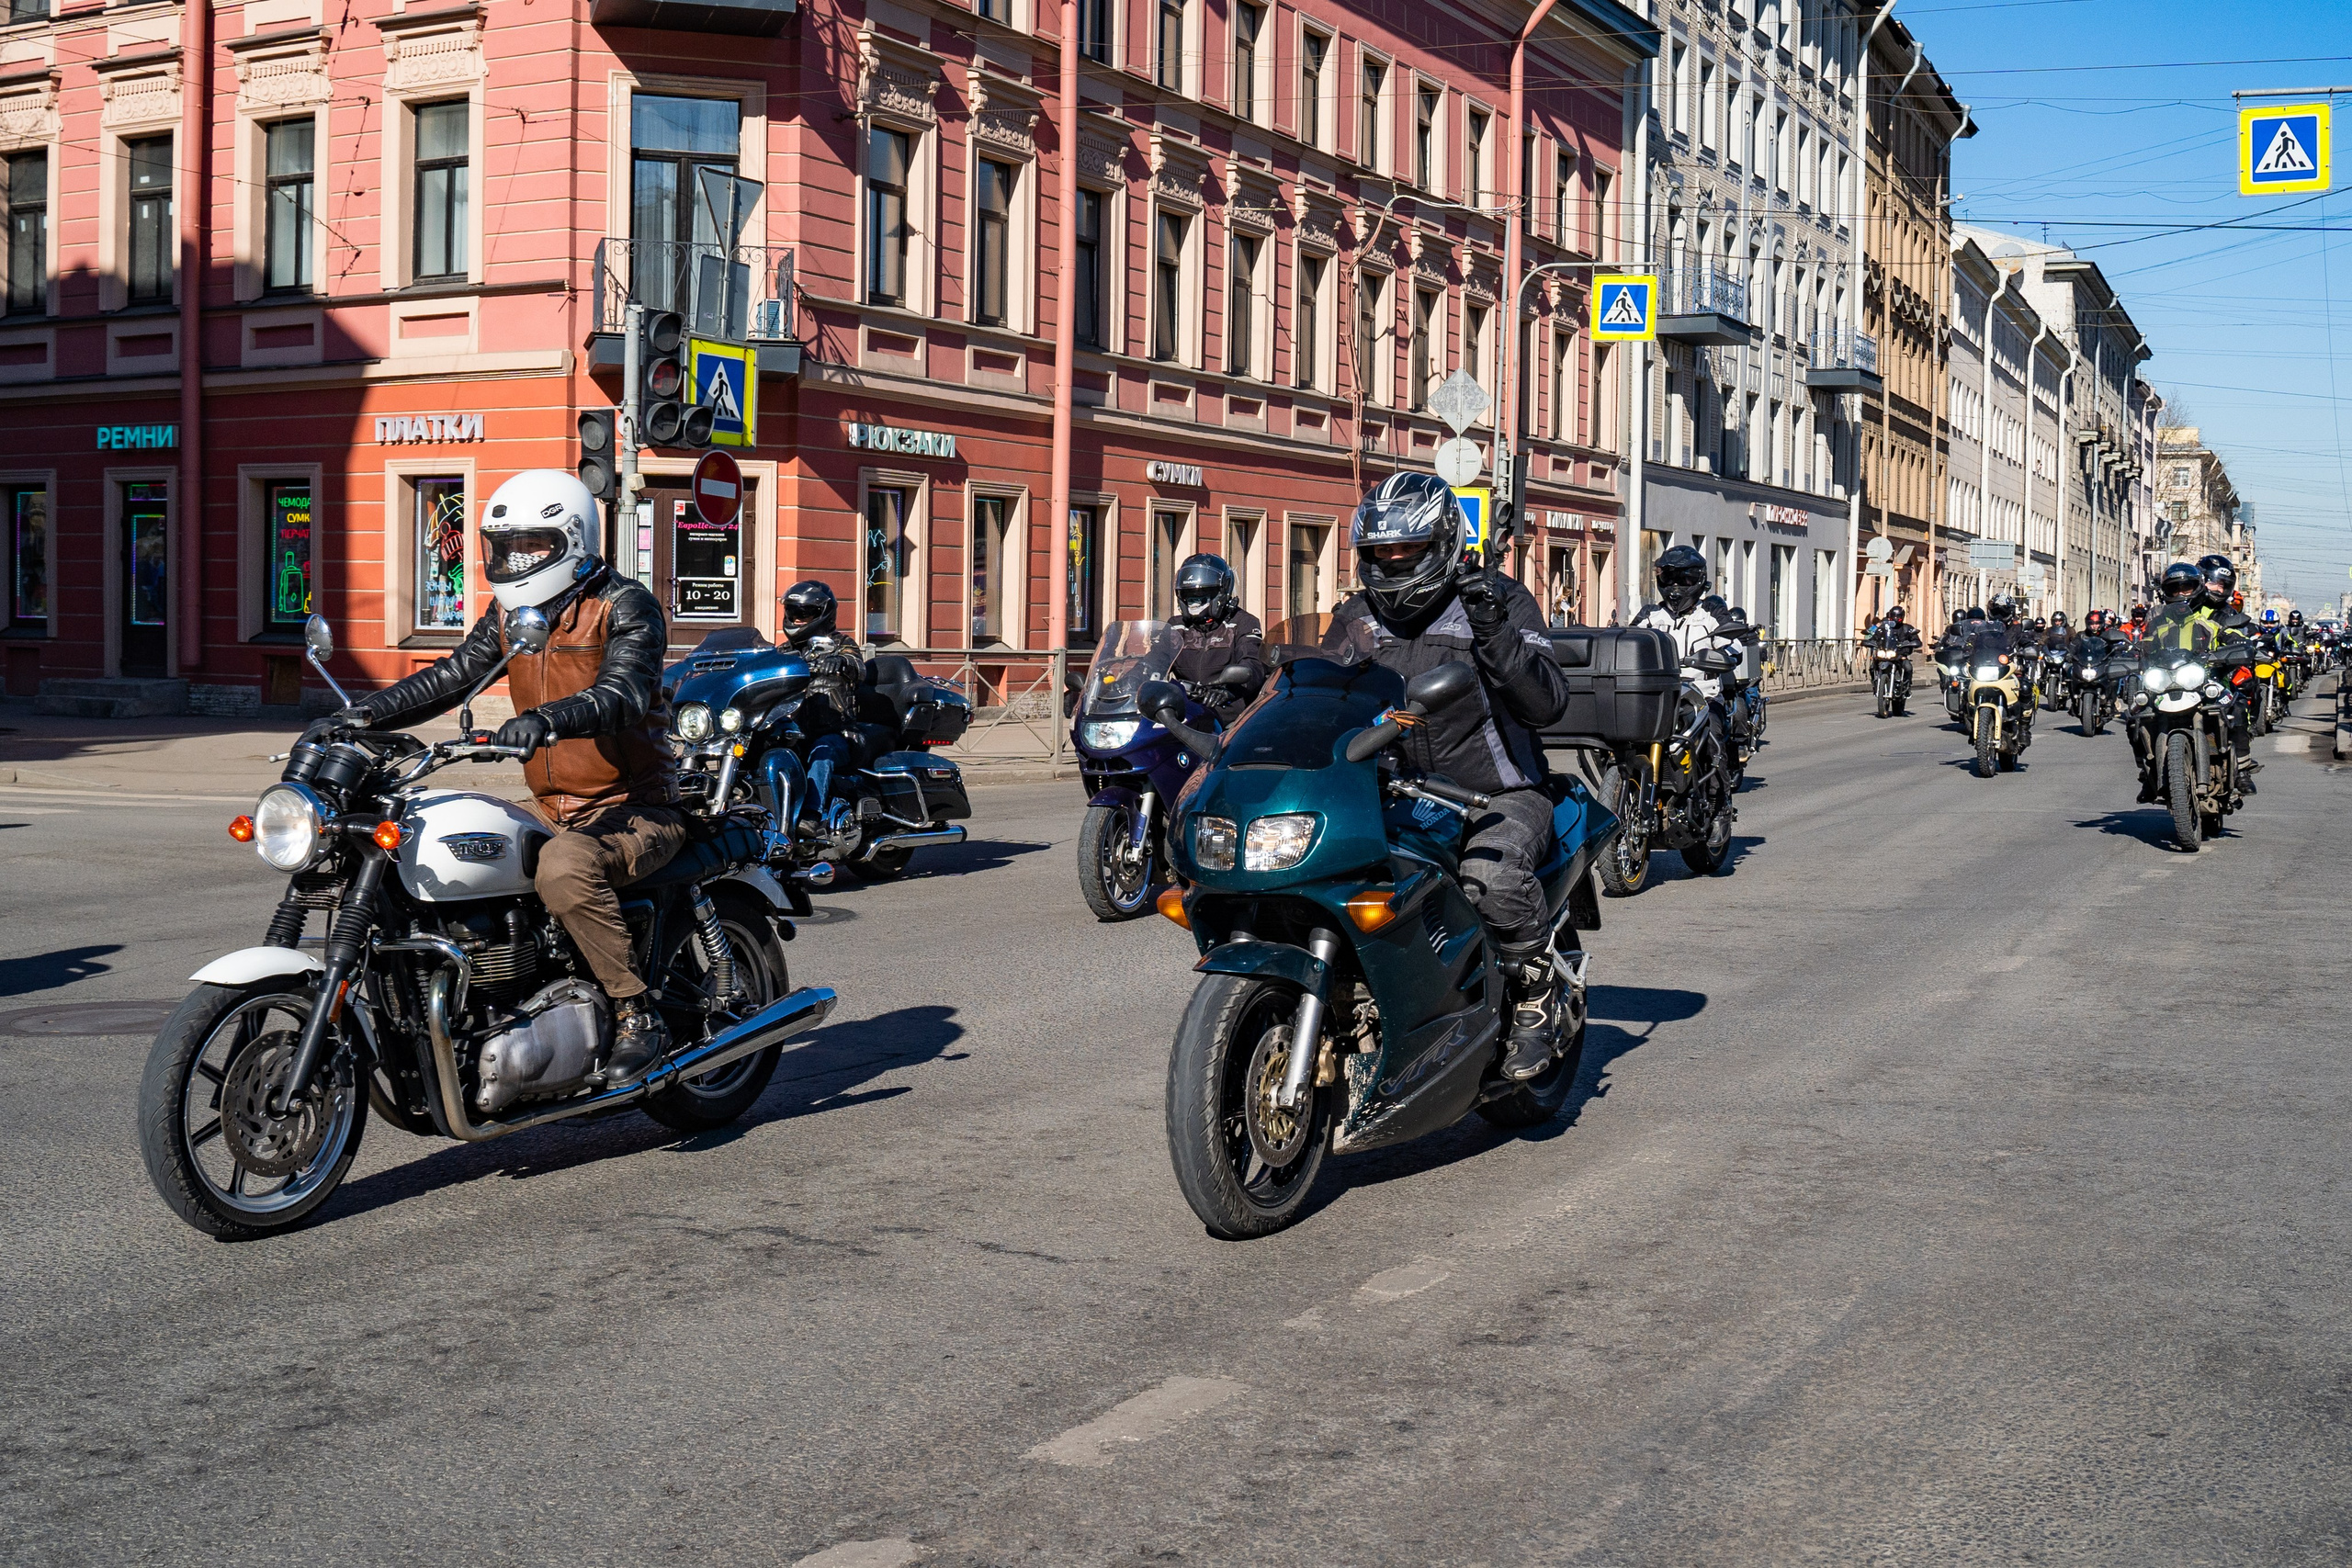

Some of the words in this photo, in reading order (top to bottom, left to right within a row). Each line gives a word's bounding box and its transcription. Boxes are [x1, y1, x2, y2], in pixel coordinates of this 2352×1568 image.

[96, 424, 175, 449] РЕМНИ
[375, 413, 484, 441] ПЛАТКИ
[853, 423, 956, 457] РЮКЗАКИ
[1149, 461, 1203, 486] СУМКИ
[541, 504, 563, 517] DGR
[1367, 529, 1403, 539] SHARK
[685, 591, 701, 600] 10
[713, 591, 730, 600] 20
[1419, 807, 1451, 830] HONDA
